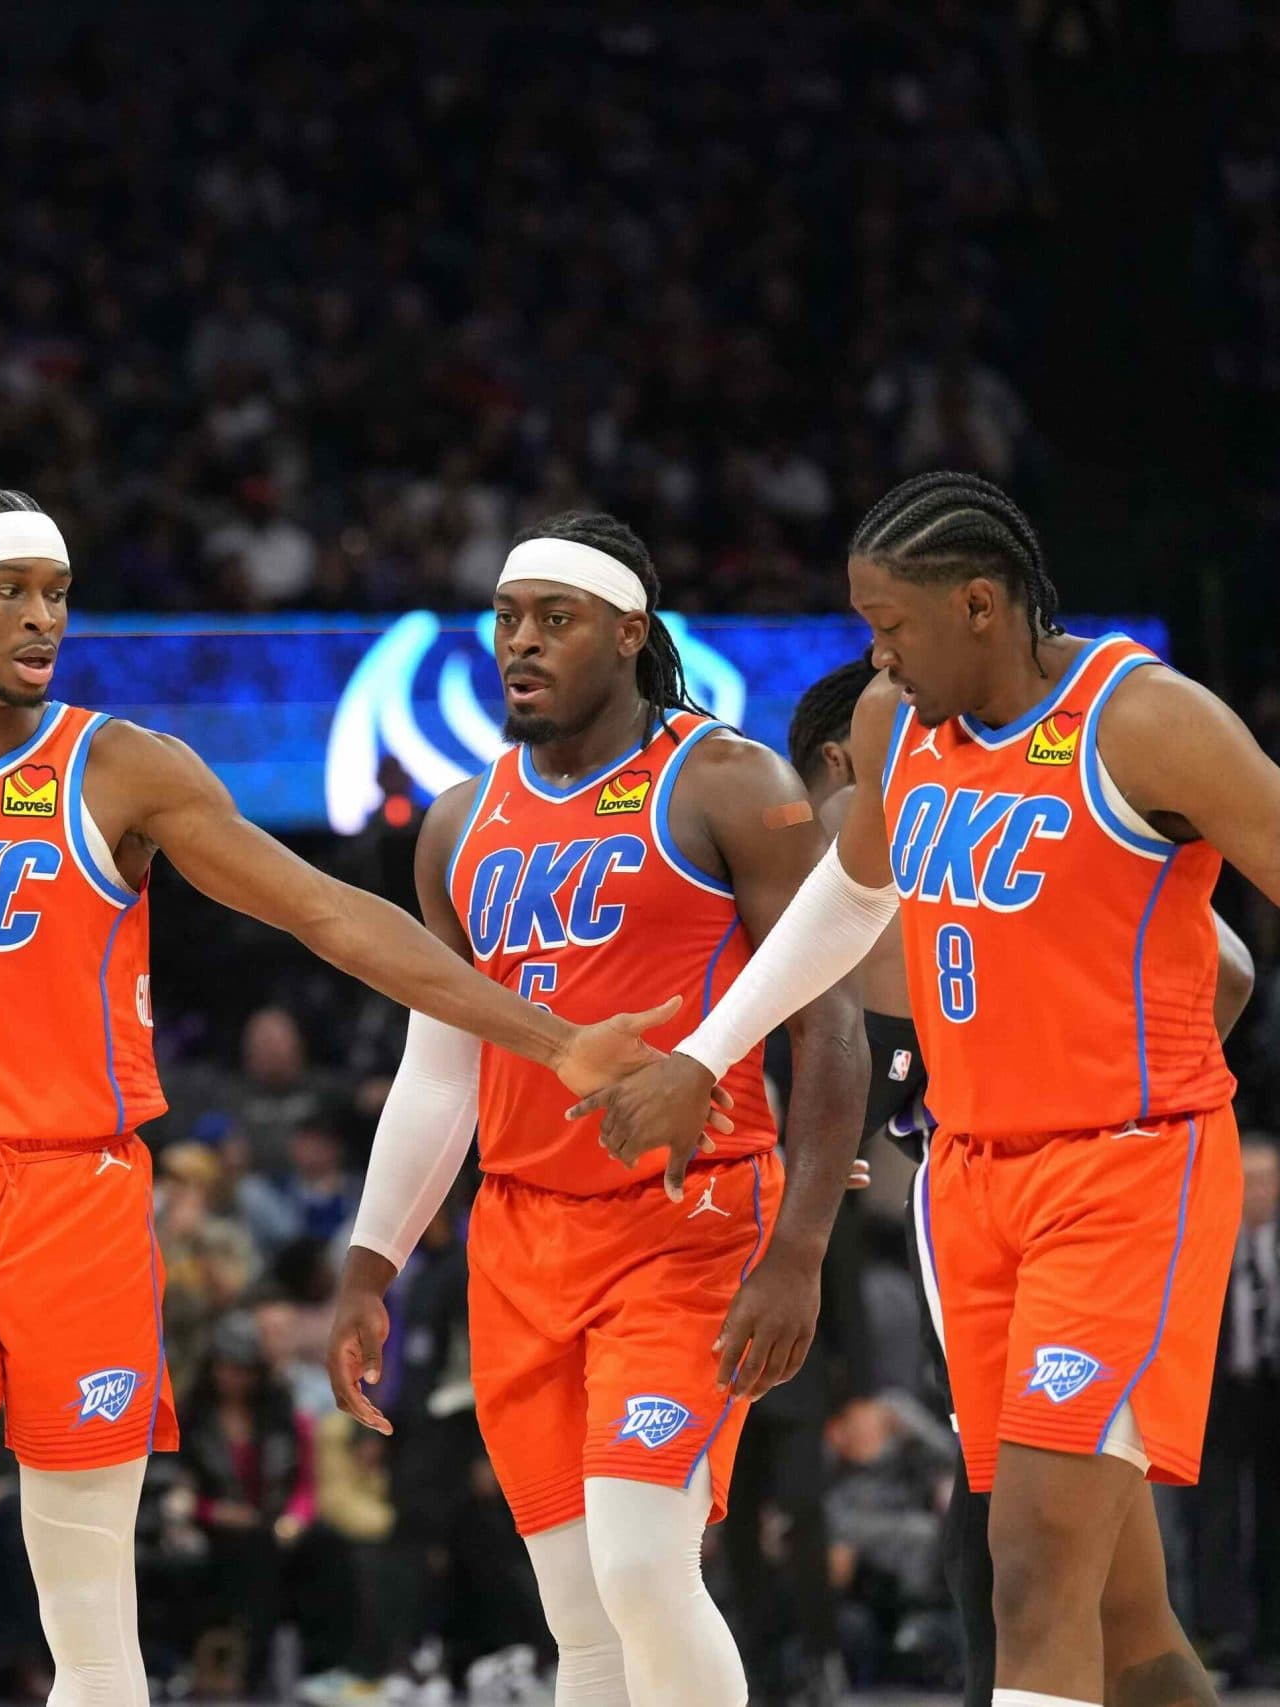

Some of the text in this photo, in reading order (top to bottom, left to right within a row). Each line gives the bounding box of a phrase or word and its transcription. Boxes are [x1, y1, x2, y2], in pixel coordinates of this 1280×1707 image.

[468, 833, 648, 962] OKC
[890, 783, 1072, 913] OKC
[936, 923, 976, 1024] 8
